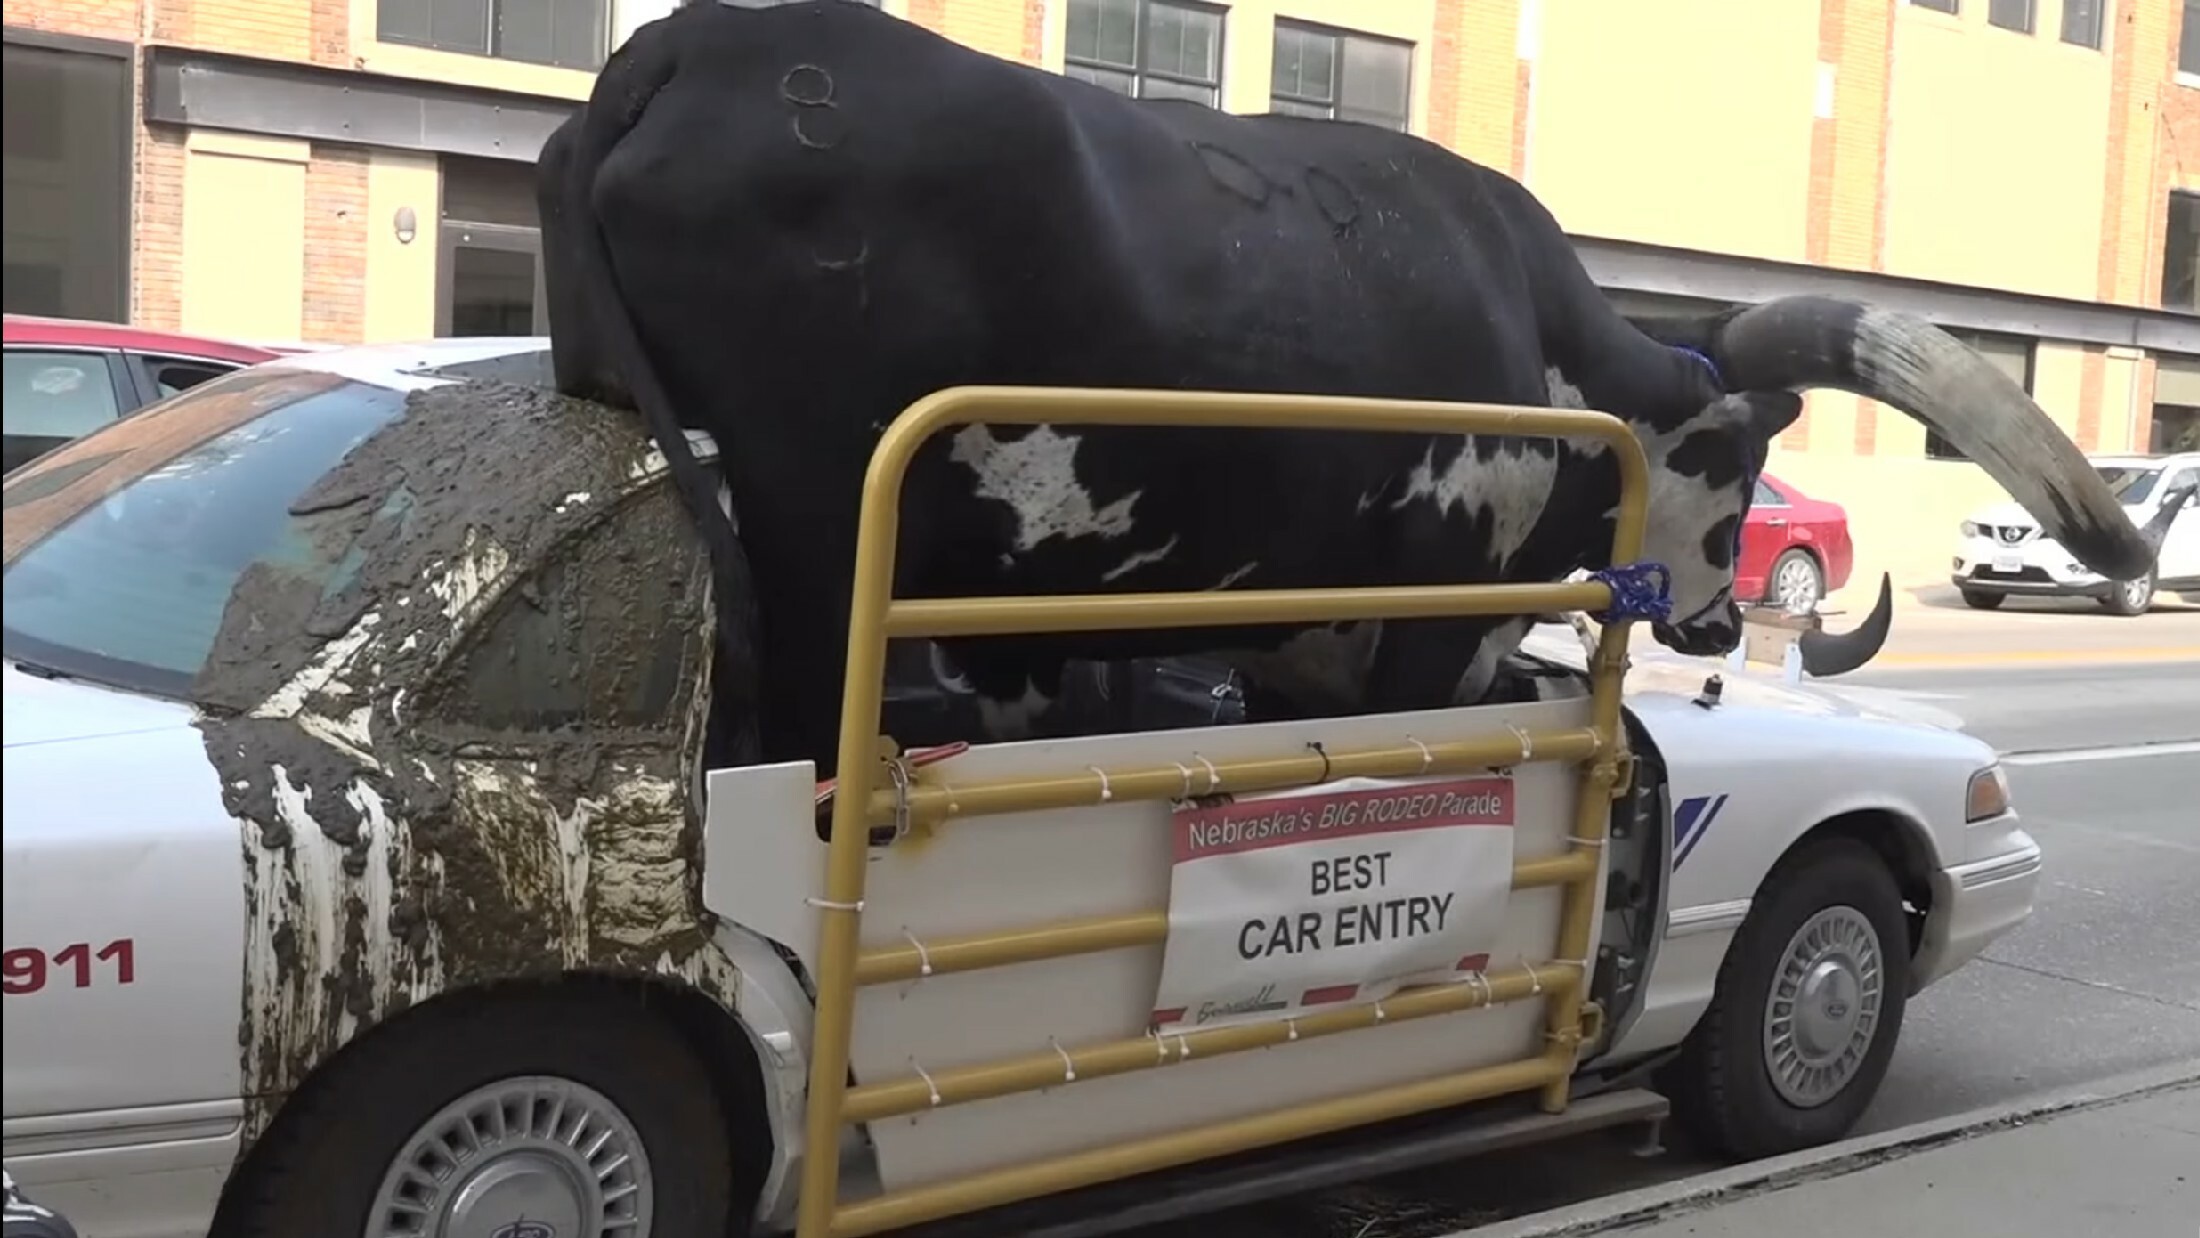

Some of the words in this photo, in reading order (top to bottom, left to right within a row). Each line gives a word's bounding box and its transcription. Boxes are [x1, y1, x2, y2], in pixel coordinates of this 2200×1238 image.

[1189, 809, 1312, 850] Nebraska's
[1318, 801, 1359, 830] BIG
[1361, 793, 1437, 825] RODEO
[1438, 790, 1501, 816] Parade
[1311, 852, 1392, 896] BEST
[1238, 912, 1322, 960] CAR
[1334, 893, 1455, 947] ENTRY
[3, 938, 134, 995] 911
